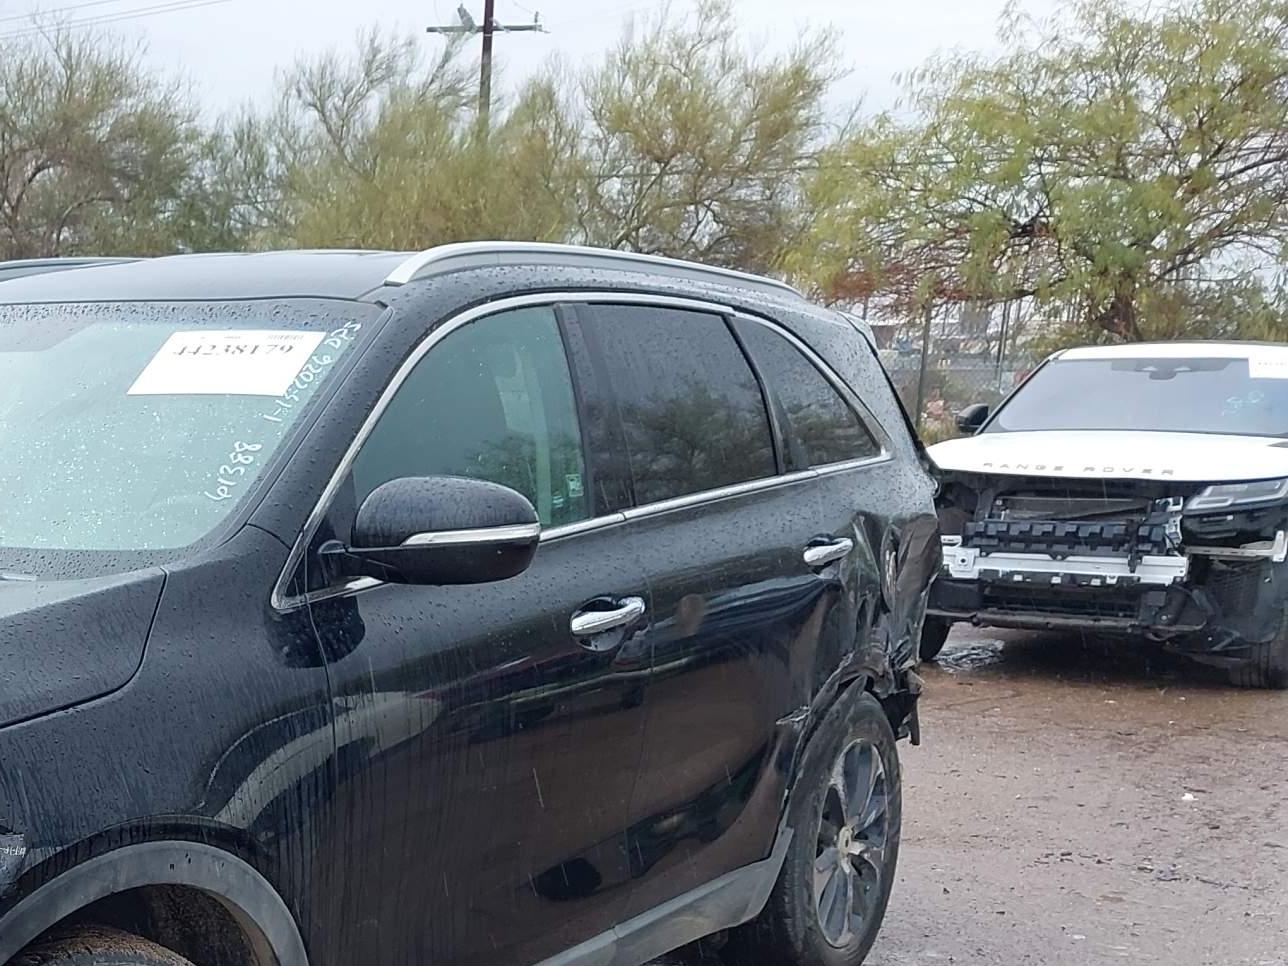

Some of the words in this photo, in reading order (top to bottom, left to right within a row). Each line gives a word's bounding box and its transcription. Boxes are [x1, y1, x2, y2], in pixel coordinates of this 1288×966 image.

[172, 343, 295, 357] 44238179
[204, 440, 263, 501] 61388
[983, 461, 1064, 471] RANGE
[1083, 466, 1174, 476] ROVER
